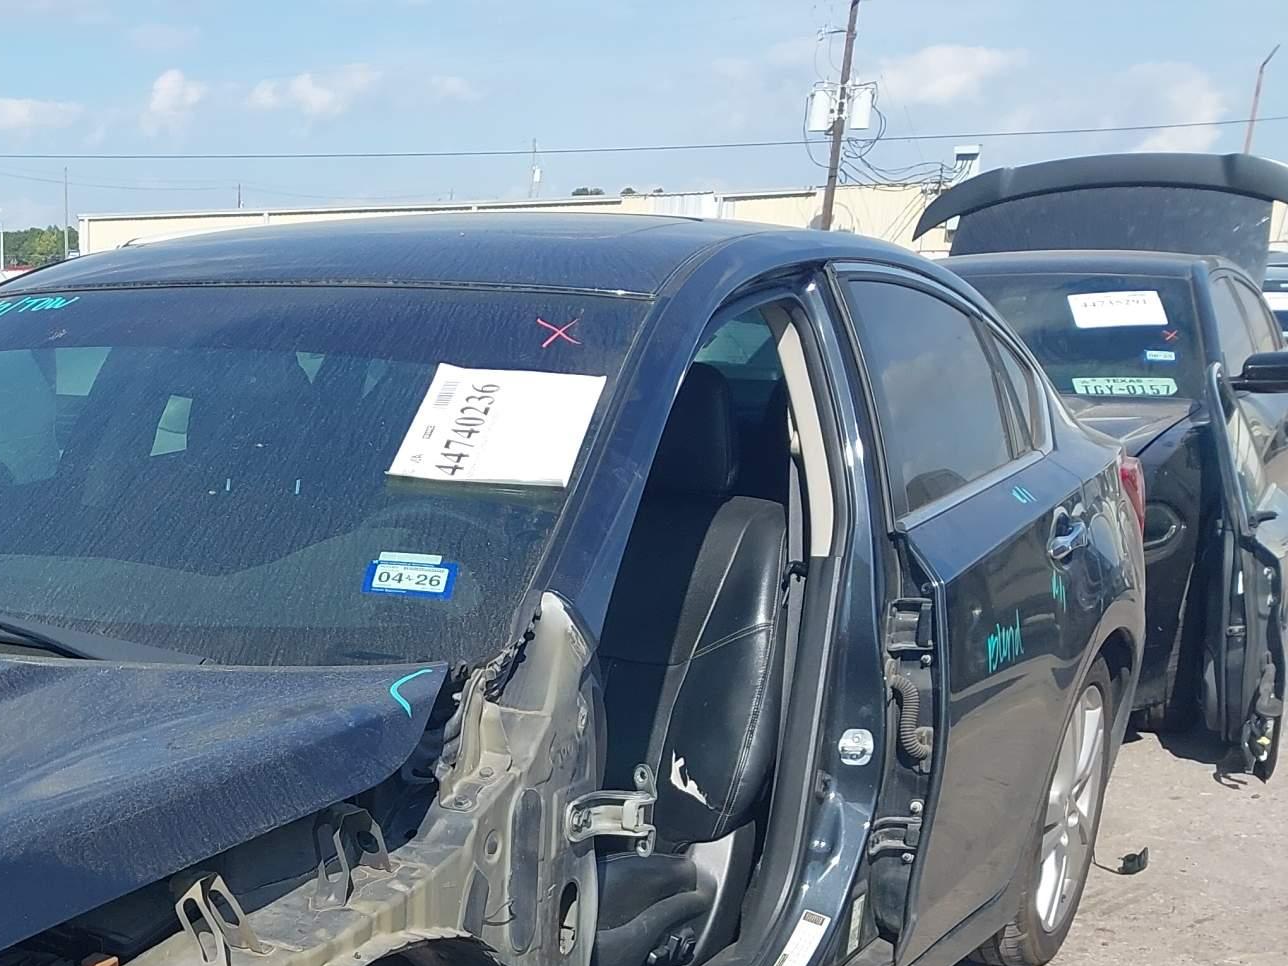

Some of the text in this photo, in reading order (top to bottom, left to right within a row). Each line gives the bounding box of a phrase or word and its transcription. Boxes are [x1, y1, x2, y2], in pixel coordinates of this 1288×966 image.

[435, 383, 500, 476] 44740236
[378, 571, 442, 588] 04 26
